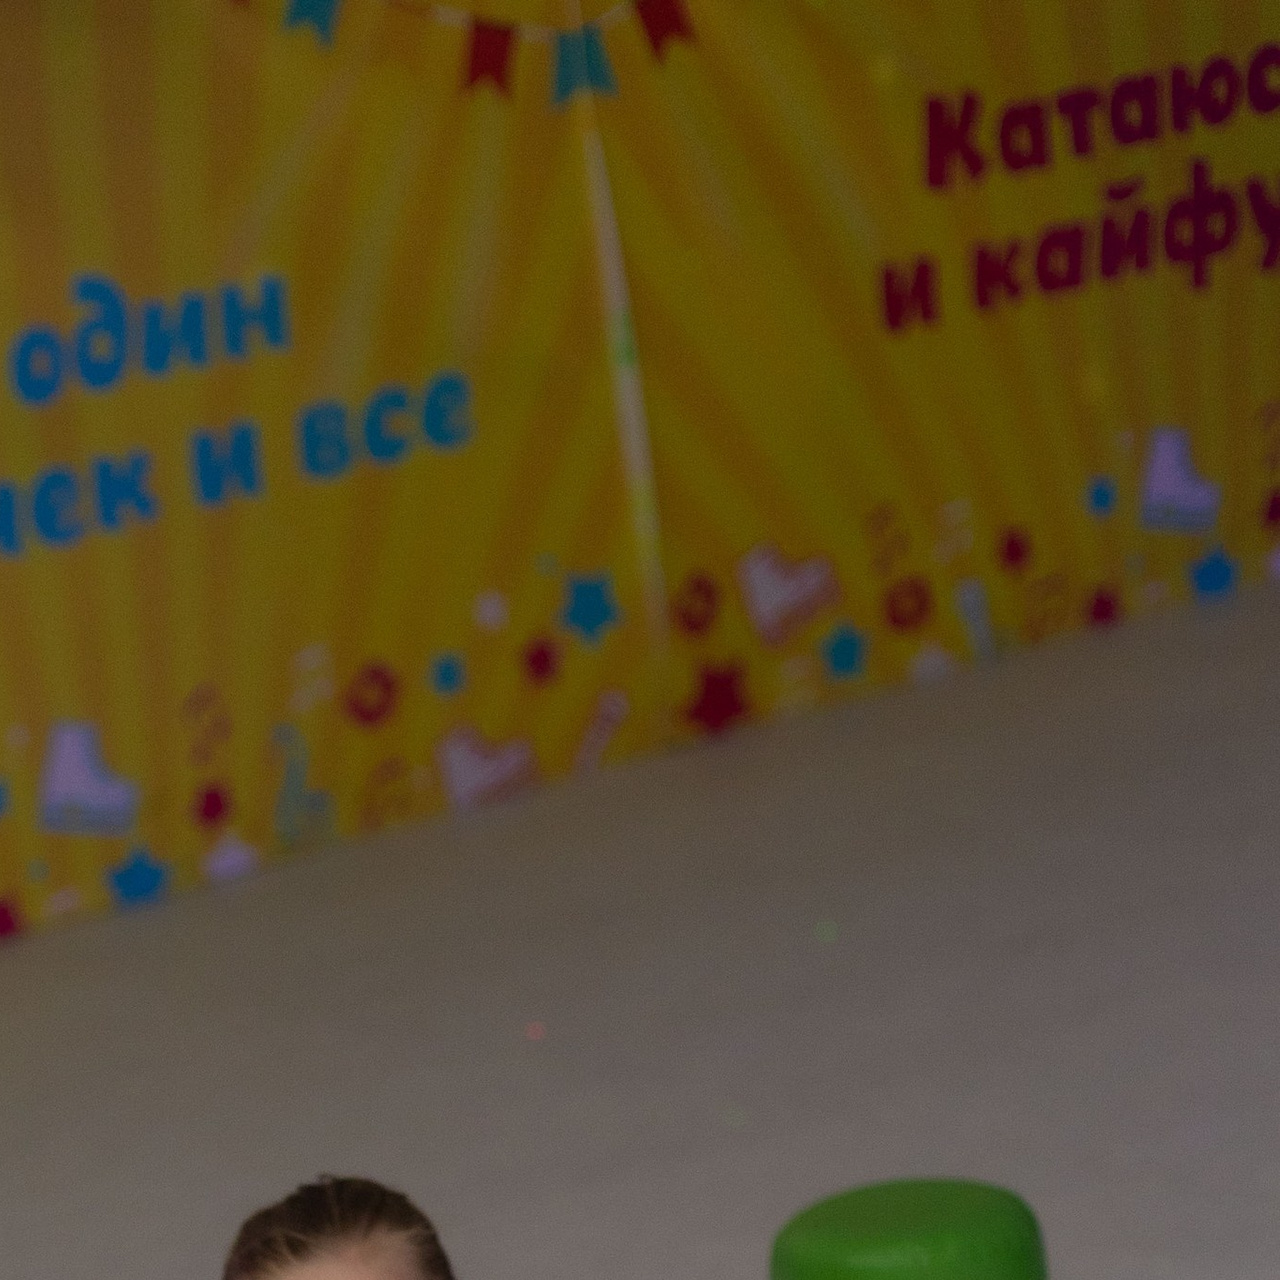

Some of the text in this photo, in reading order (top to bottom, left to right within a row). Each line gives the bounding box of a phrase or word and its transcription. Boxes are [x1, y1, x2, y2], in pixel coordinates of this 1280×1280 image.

[8, 274, 290, 407] один
[881, 257, 940, 332] и
[191, 422, 263, 506] и
[298, 372, 474, 478] все
